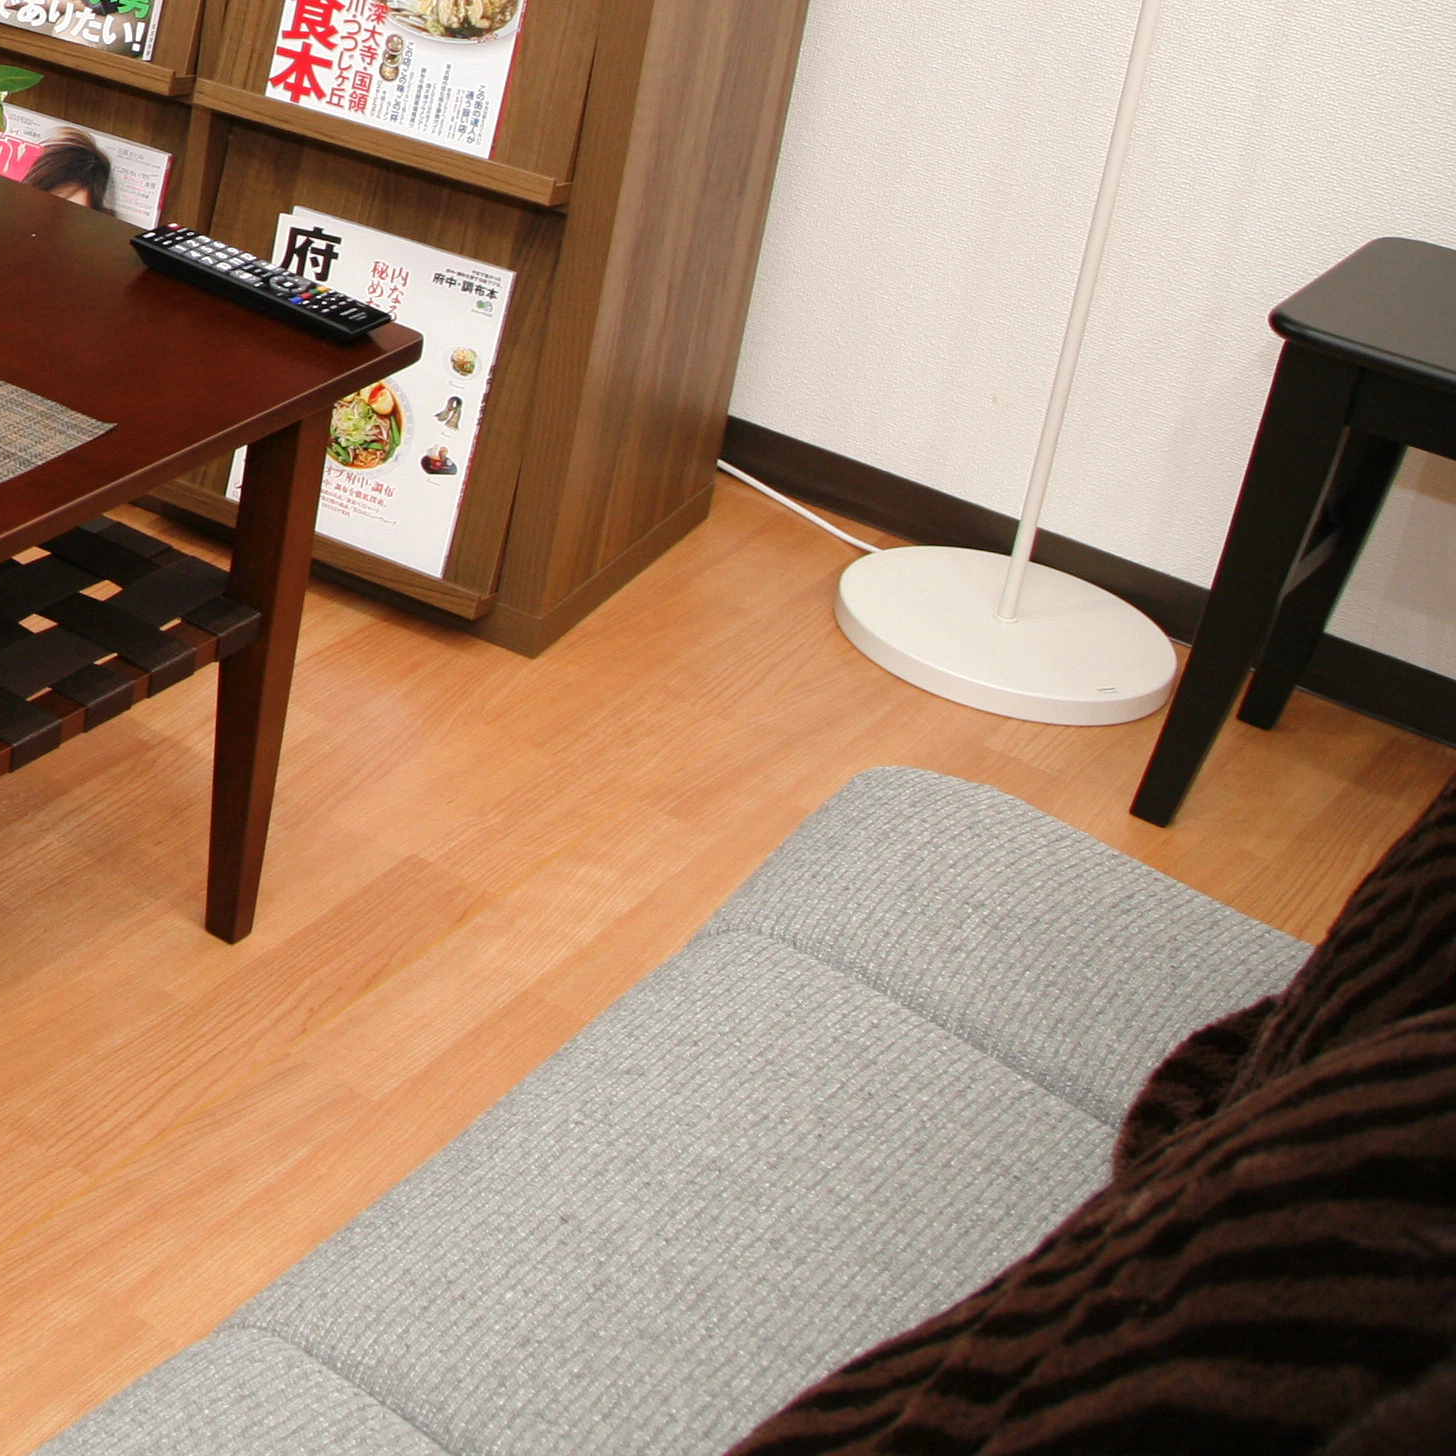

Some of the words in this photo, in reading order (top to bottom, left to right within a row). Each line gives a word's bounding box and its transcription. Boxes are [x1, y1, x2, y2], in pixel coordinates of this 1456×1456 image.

[347, 0, 390, 114] 深大寺・国領
[277, 225, 343, 283] 府
[431, 272, 501, 301] 府中・調布本
